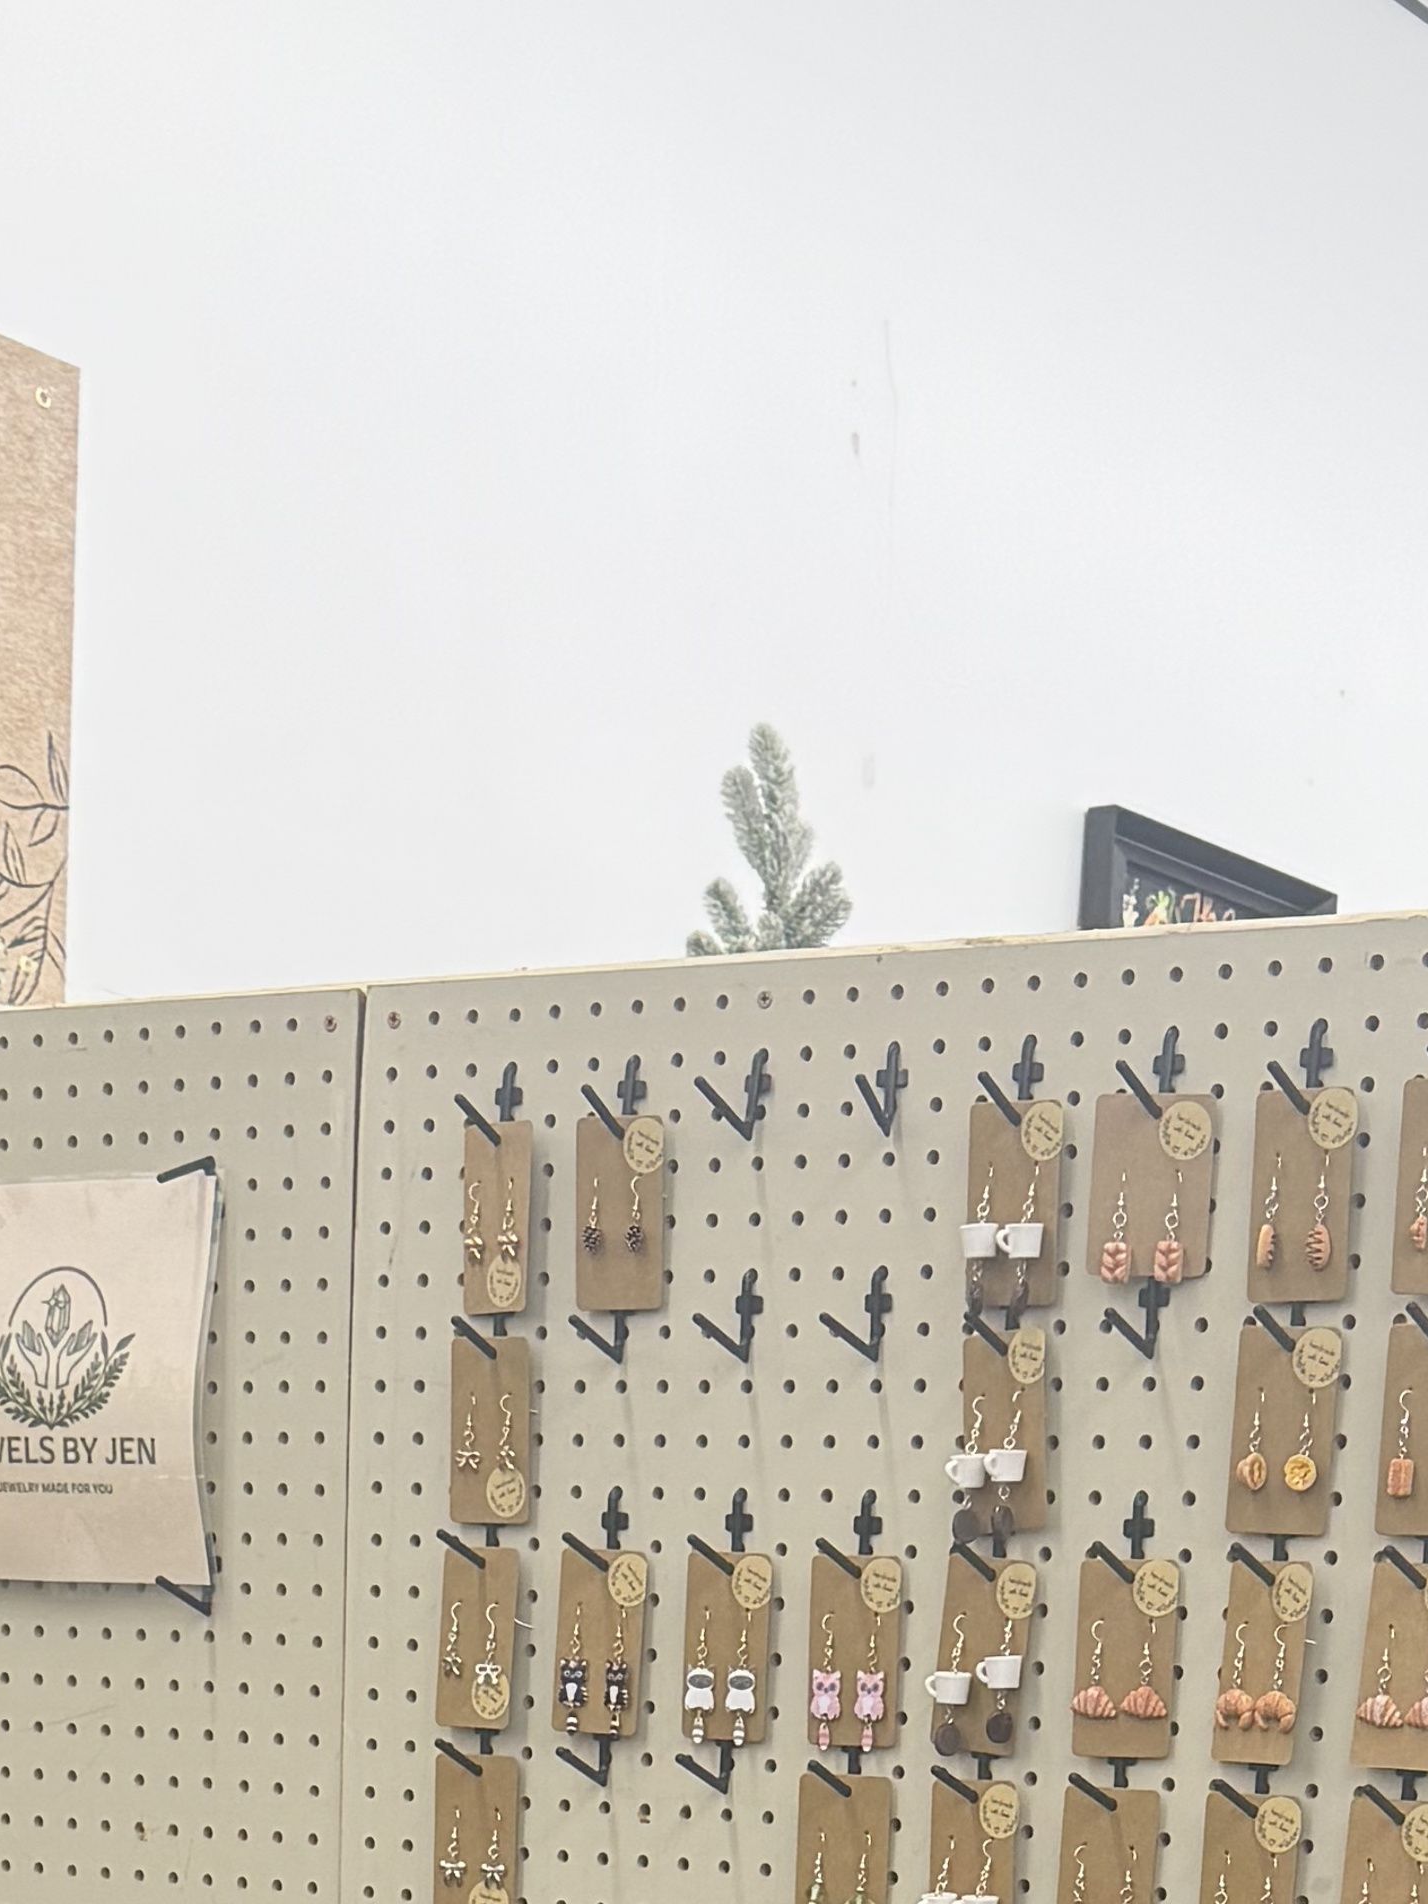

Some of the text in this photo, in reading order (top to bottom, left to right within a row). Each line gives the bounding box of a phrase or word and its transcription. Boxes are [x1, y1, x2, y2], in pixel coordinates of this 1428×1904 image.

[62, 1437, 99, 1465] BY
[105, 1436, 156, 1465] JEN
[41, 1482, 70, 1495] MADE
[72, 1482, 91, 1495] FOR
[93, 1482, 113, 1495] YOU
